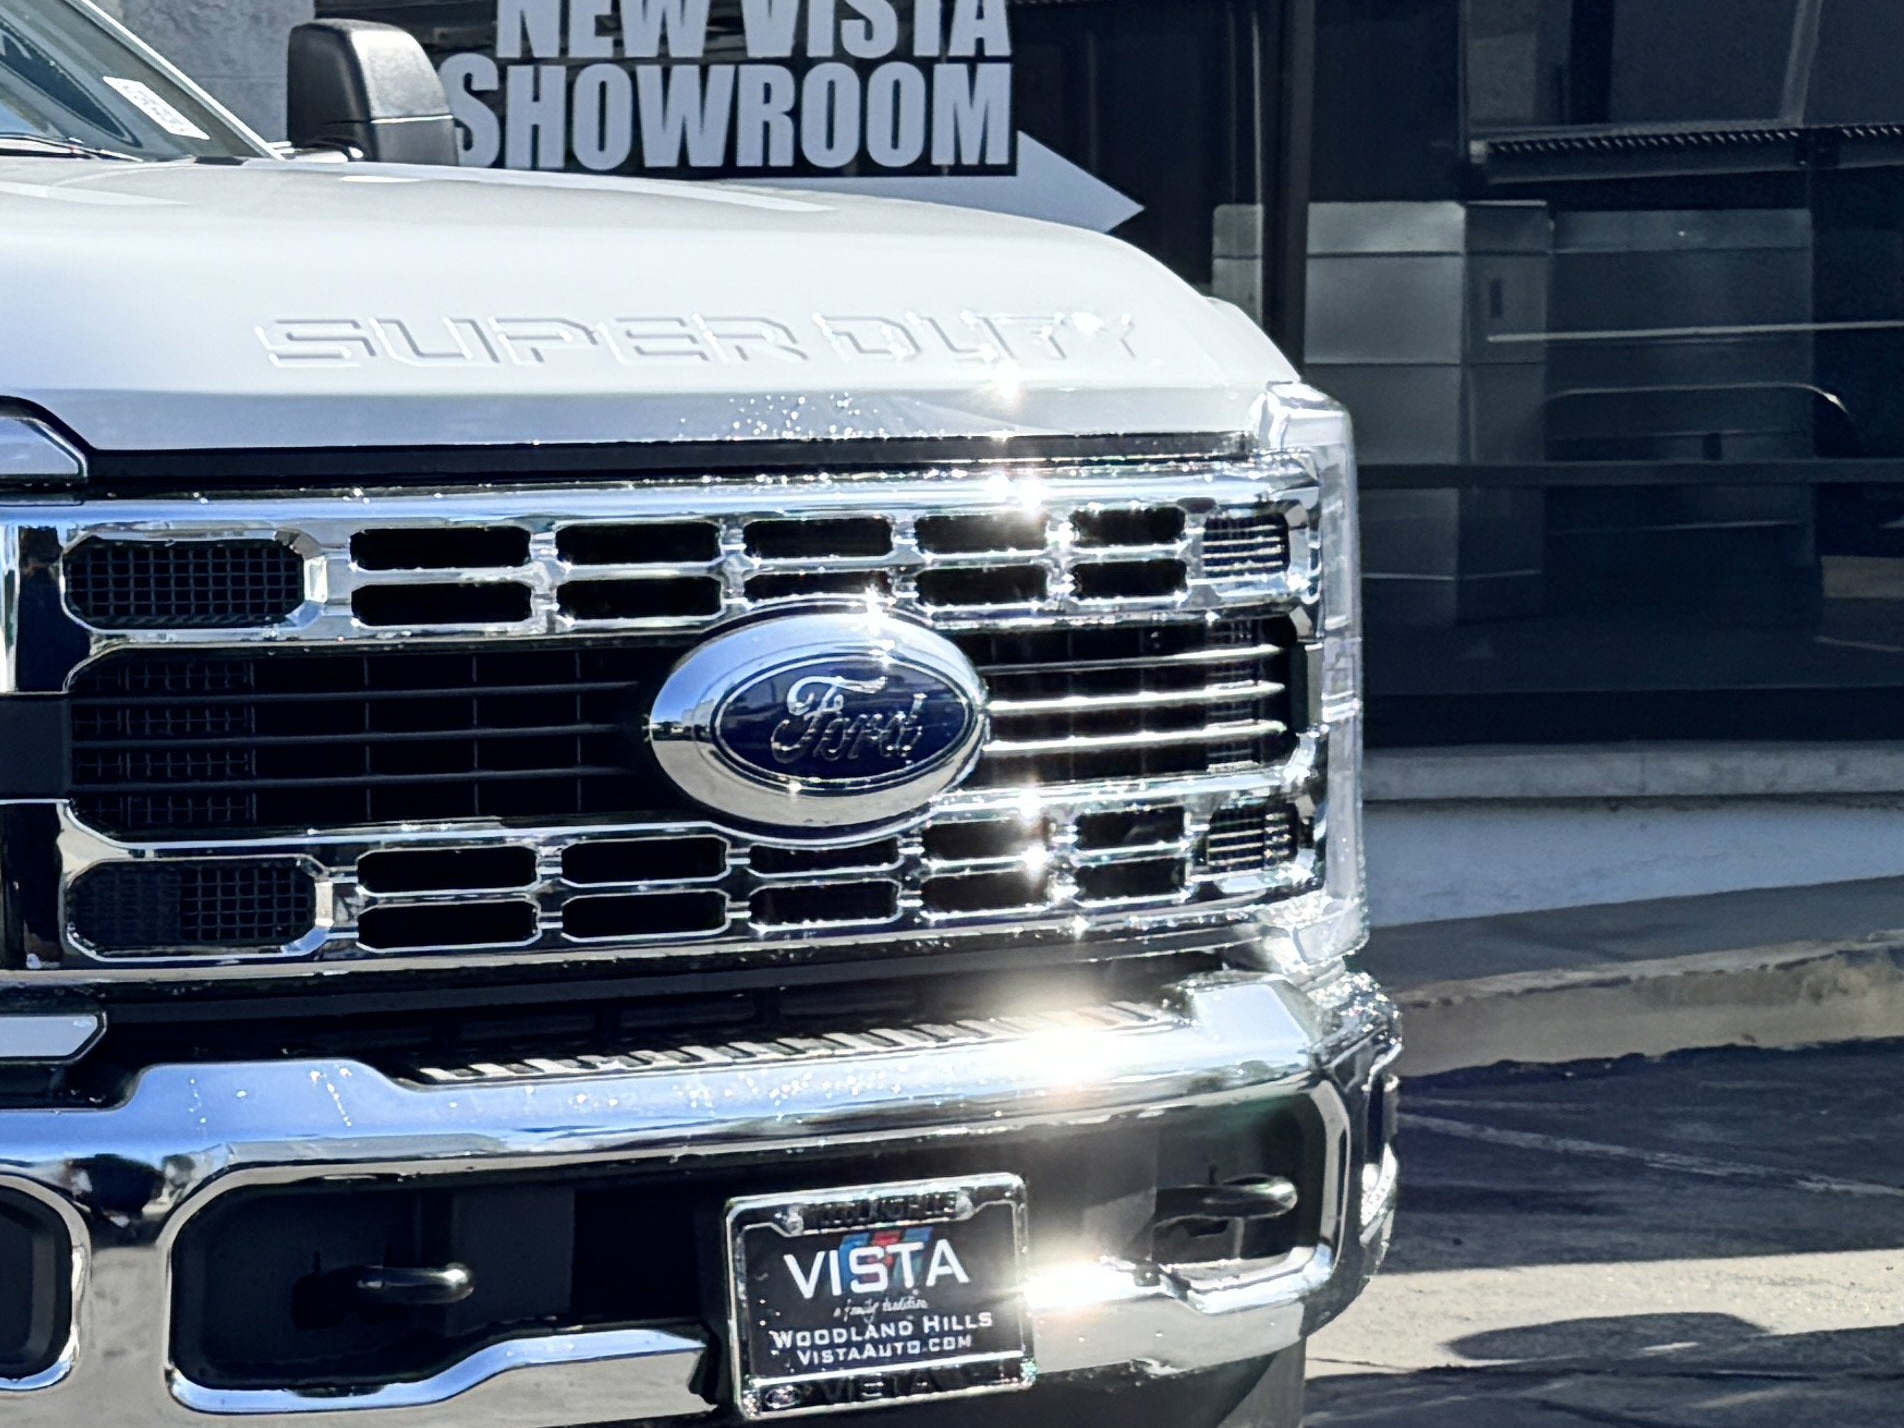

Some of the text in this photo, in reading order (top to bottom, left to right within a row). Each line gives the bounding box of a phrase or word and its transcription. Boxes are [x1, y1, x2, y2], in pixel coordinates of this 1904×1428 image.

[256, 309, 1140, 368] SUPER DUTY
[770, 675, 929, 764] Ford
[783, 1238, 970, 1299] VISTA
